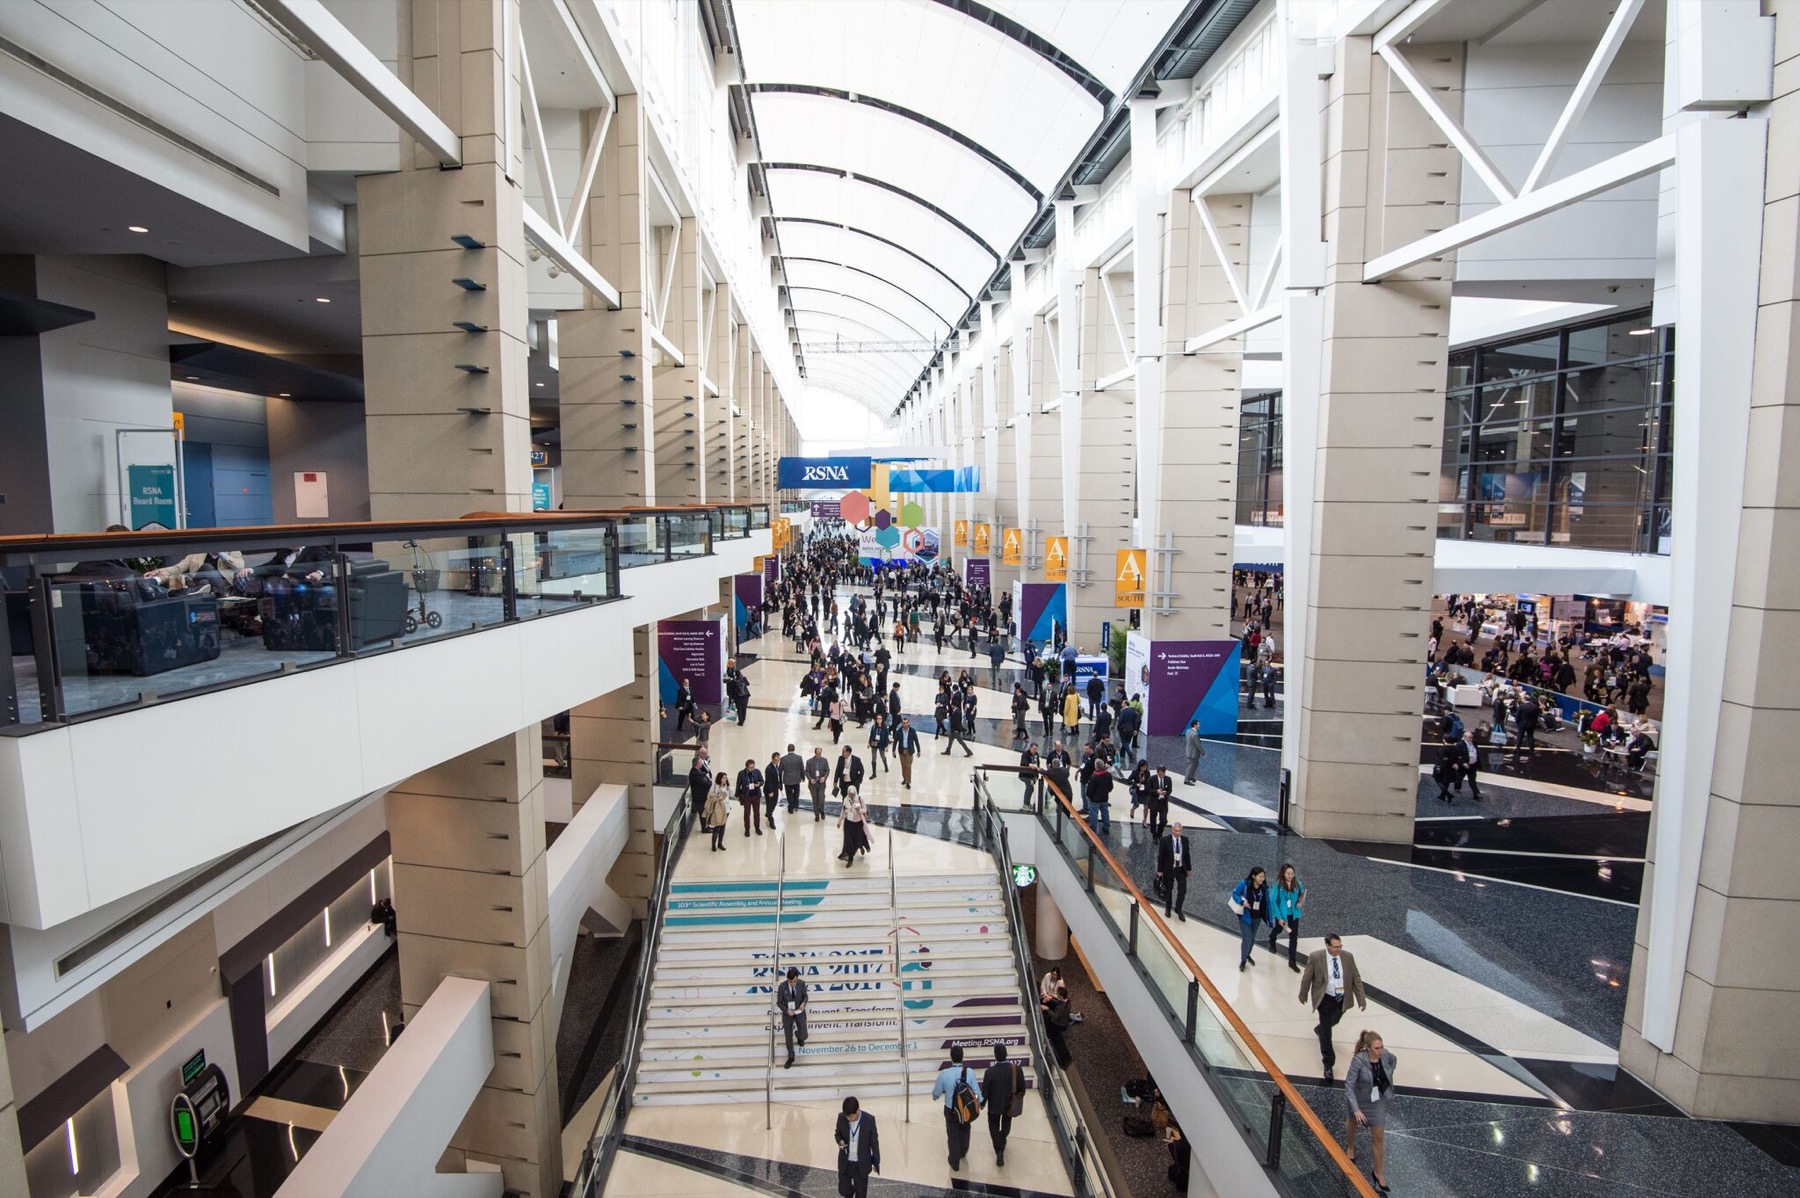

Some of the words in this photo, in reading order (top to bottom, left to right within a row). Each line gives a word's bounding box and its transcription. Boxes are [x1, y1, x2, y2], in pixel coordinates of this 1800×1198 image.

[142, 486, 162, 495] RSNA
[133, 497, 152, 505] Board
[154, 497, 173, 505] Room
[955, 521, 966, 534] A
[976, 524, 988, 540] A
[1004, 530, 1020, 548] A
[1046, 538, 1067, 561] A
[1060, 555, 1065, 568] 1
[1117, 552, 1144, 580] A
[1136, 574, 1141, 590] 1
[952, 1038, 1019, 1047] Meeting.RSNA.org
[798, 1046, 843, 1054] November
